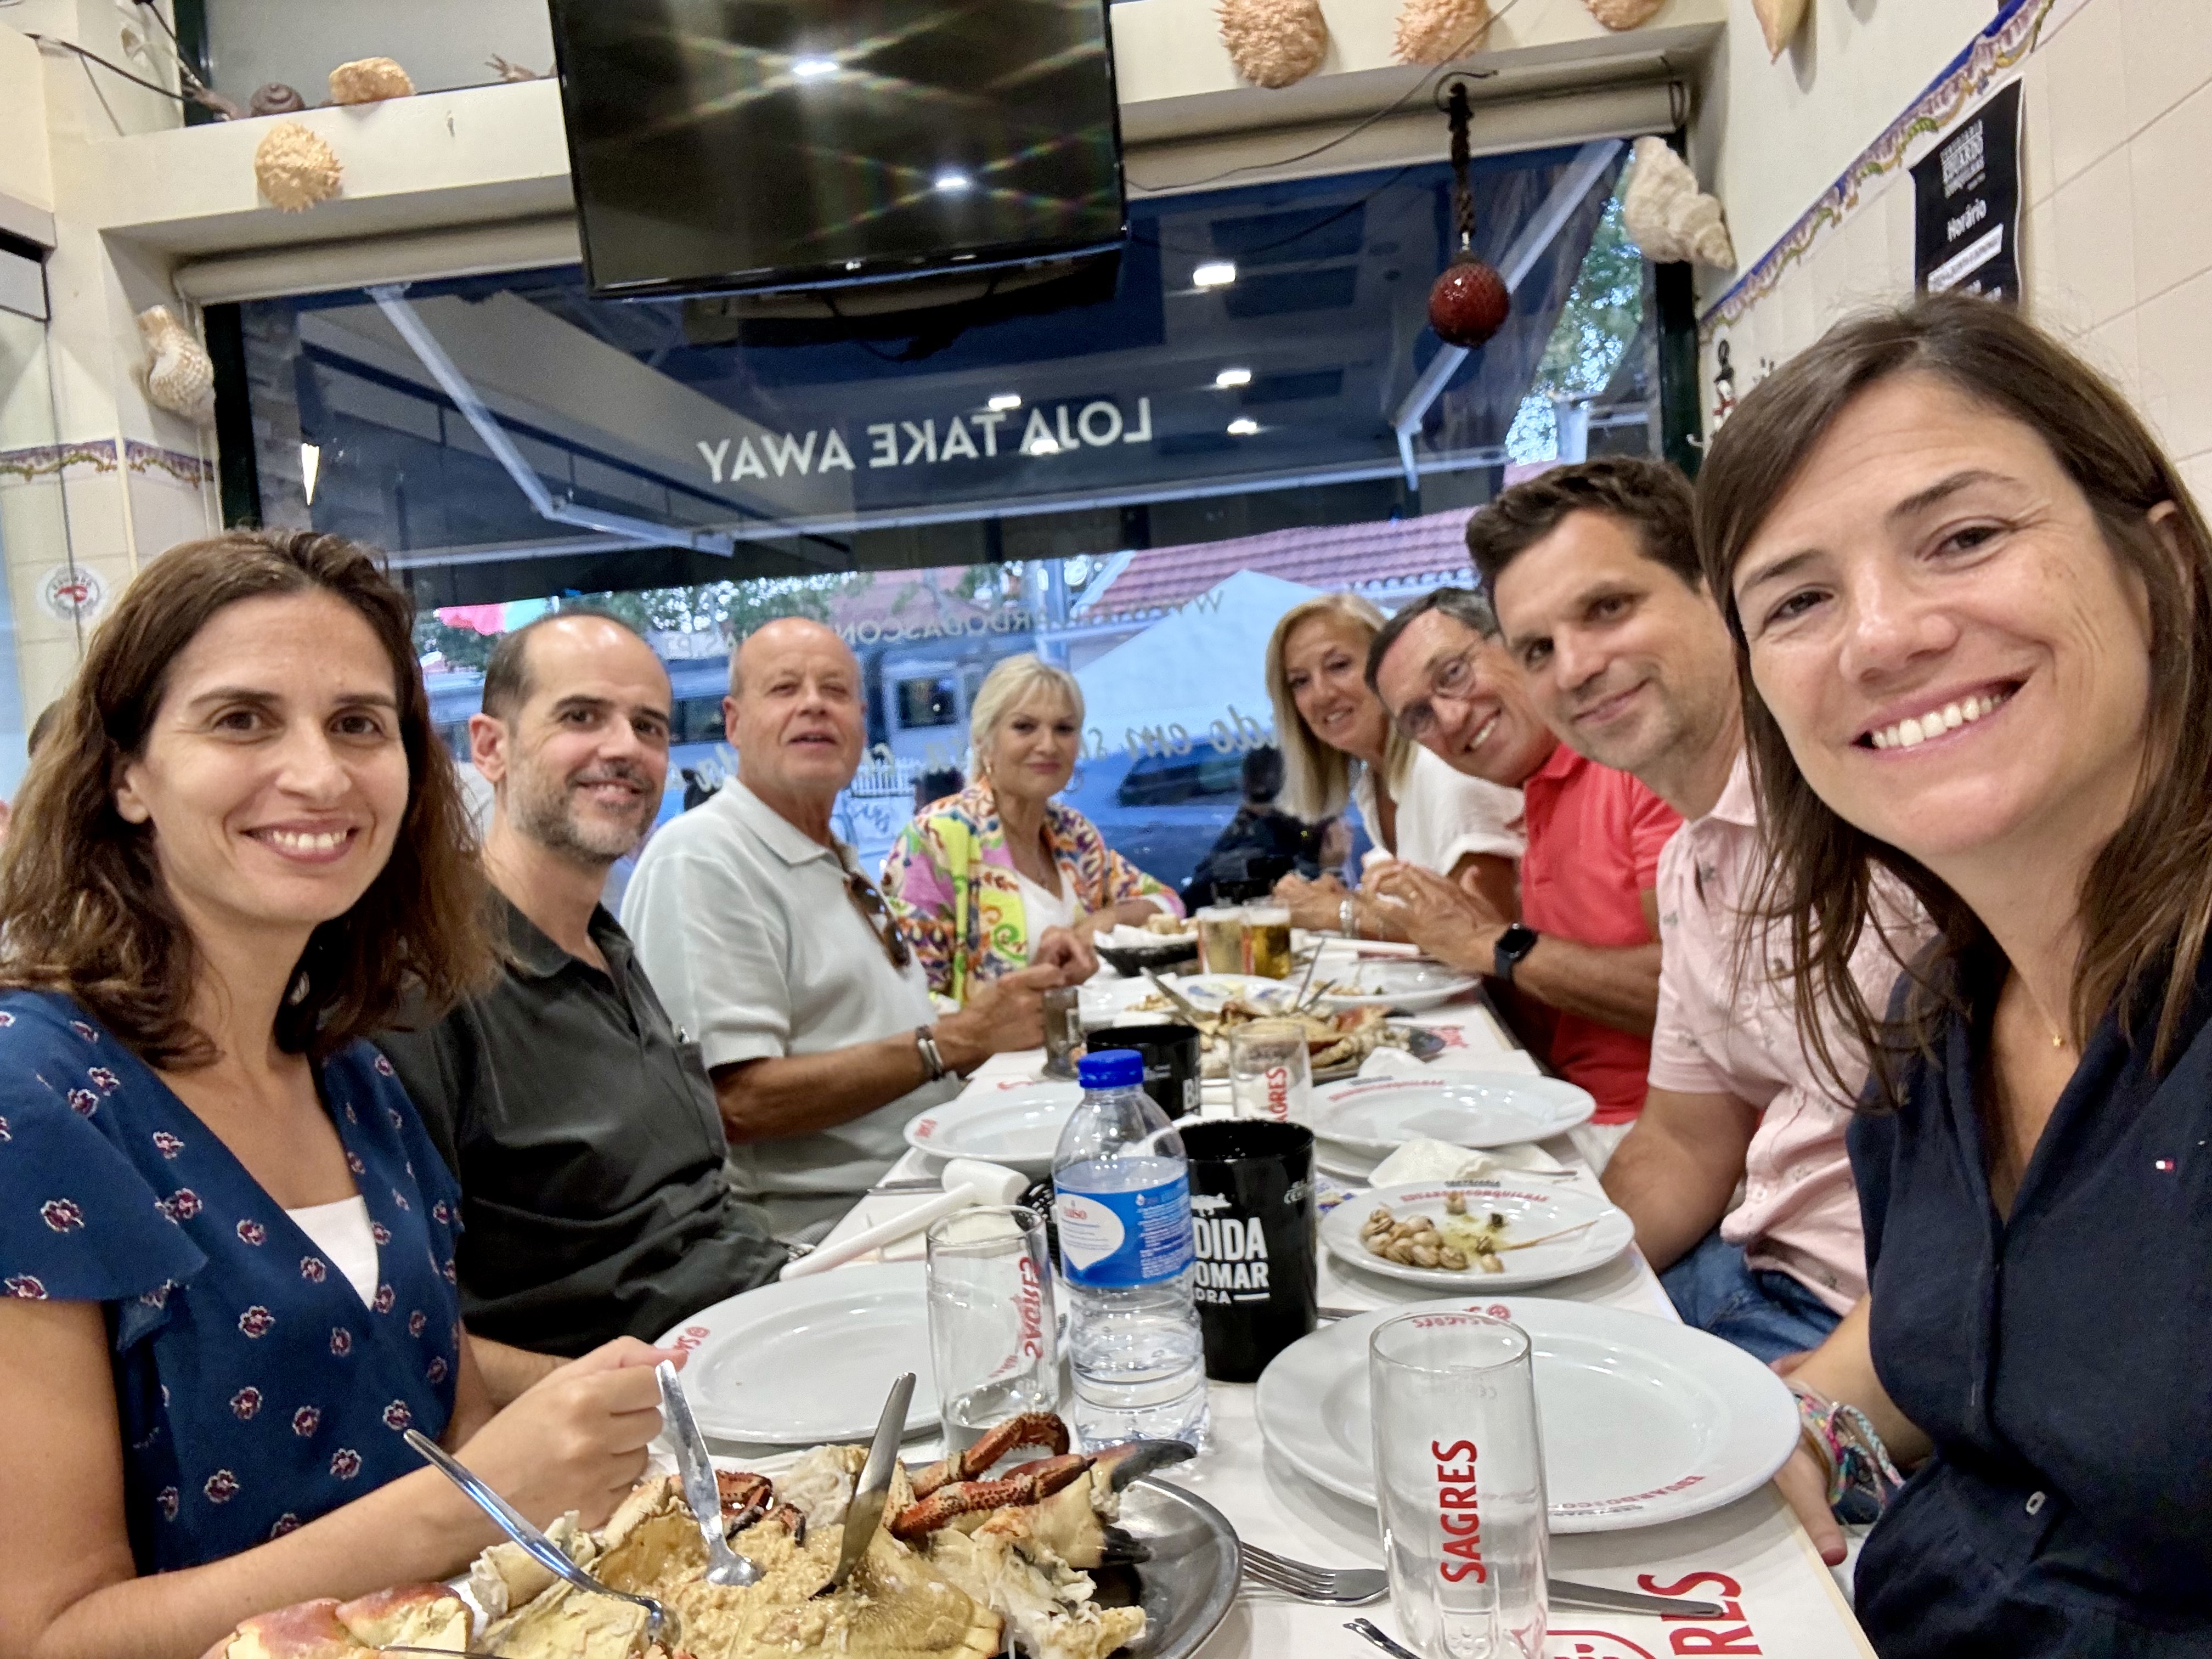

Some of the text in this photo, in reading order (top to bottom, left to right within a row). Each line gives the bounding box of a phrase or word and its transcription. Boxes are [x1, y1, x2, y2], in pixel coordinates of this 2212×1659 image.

[1265, 1066, 1289, 1123] AGRES
[1192, 1216, 1268, 1261] DIDA
[1194, 1261, 1269, 1289] OMAR
[1194, 1288, 1232, 1304] DRA
[1431, 1440, 1486, 1584] SAGRES
